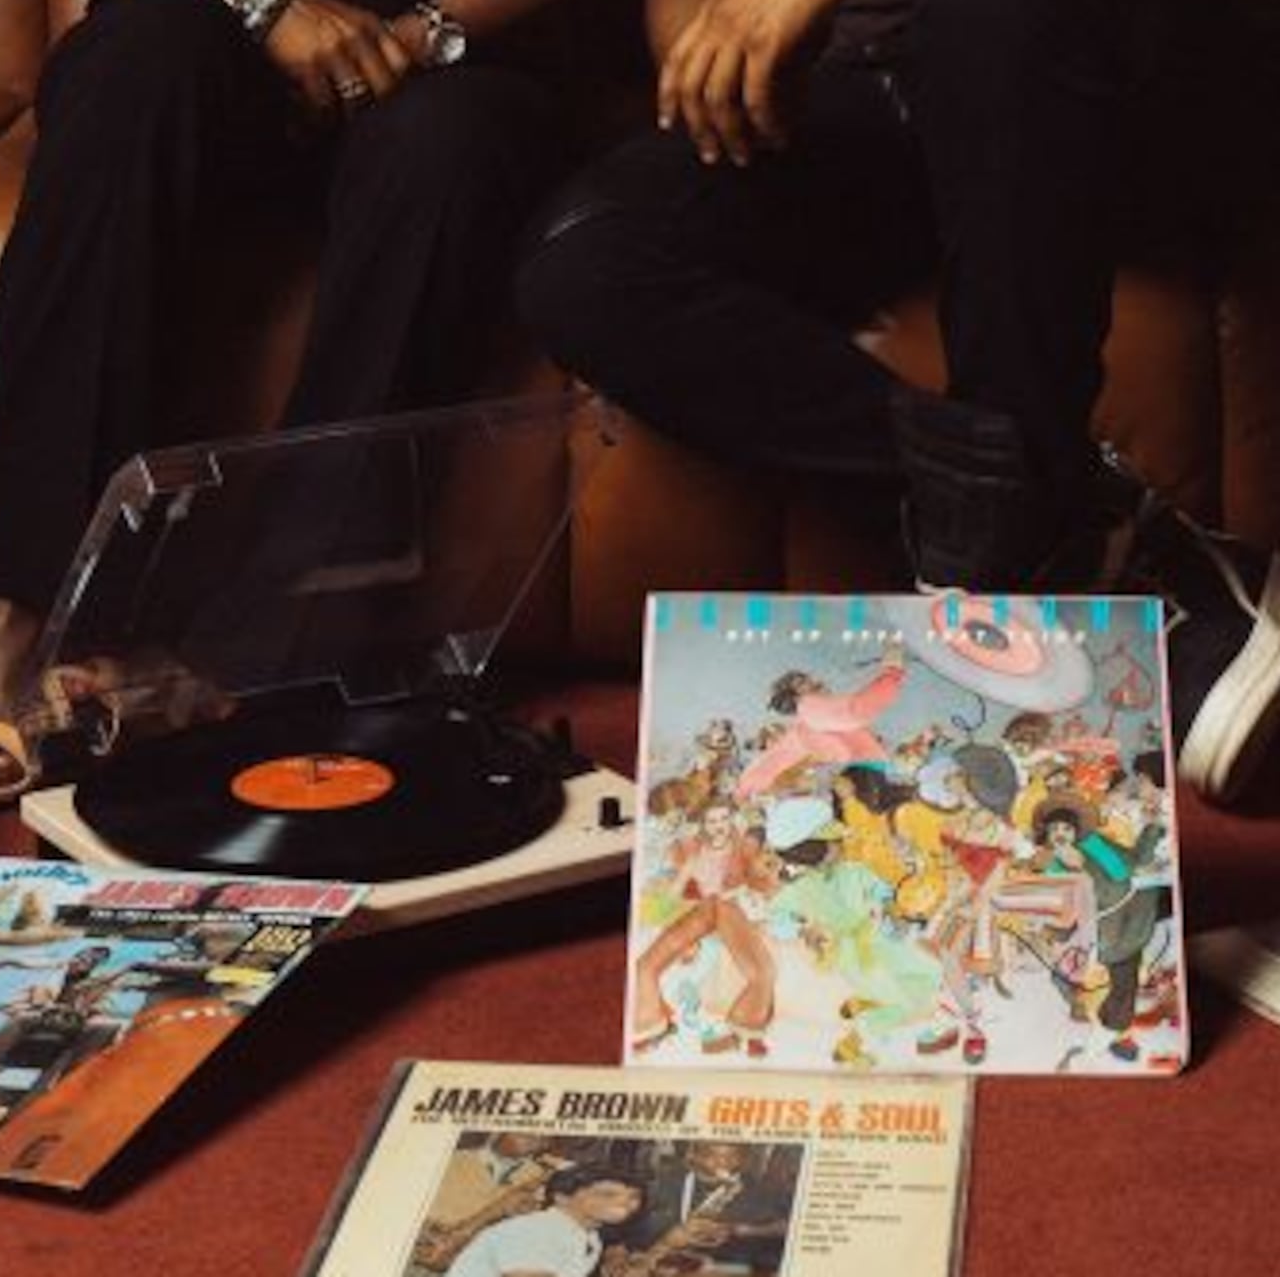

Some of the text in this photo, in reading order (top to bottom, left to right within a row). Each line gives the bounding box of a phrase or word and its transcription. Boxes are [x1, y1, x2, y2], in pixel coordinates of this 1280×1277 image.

[414, 1088, 944, 1134] JAMES BROWN GRITS & SOUL
